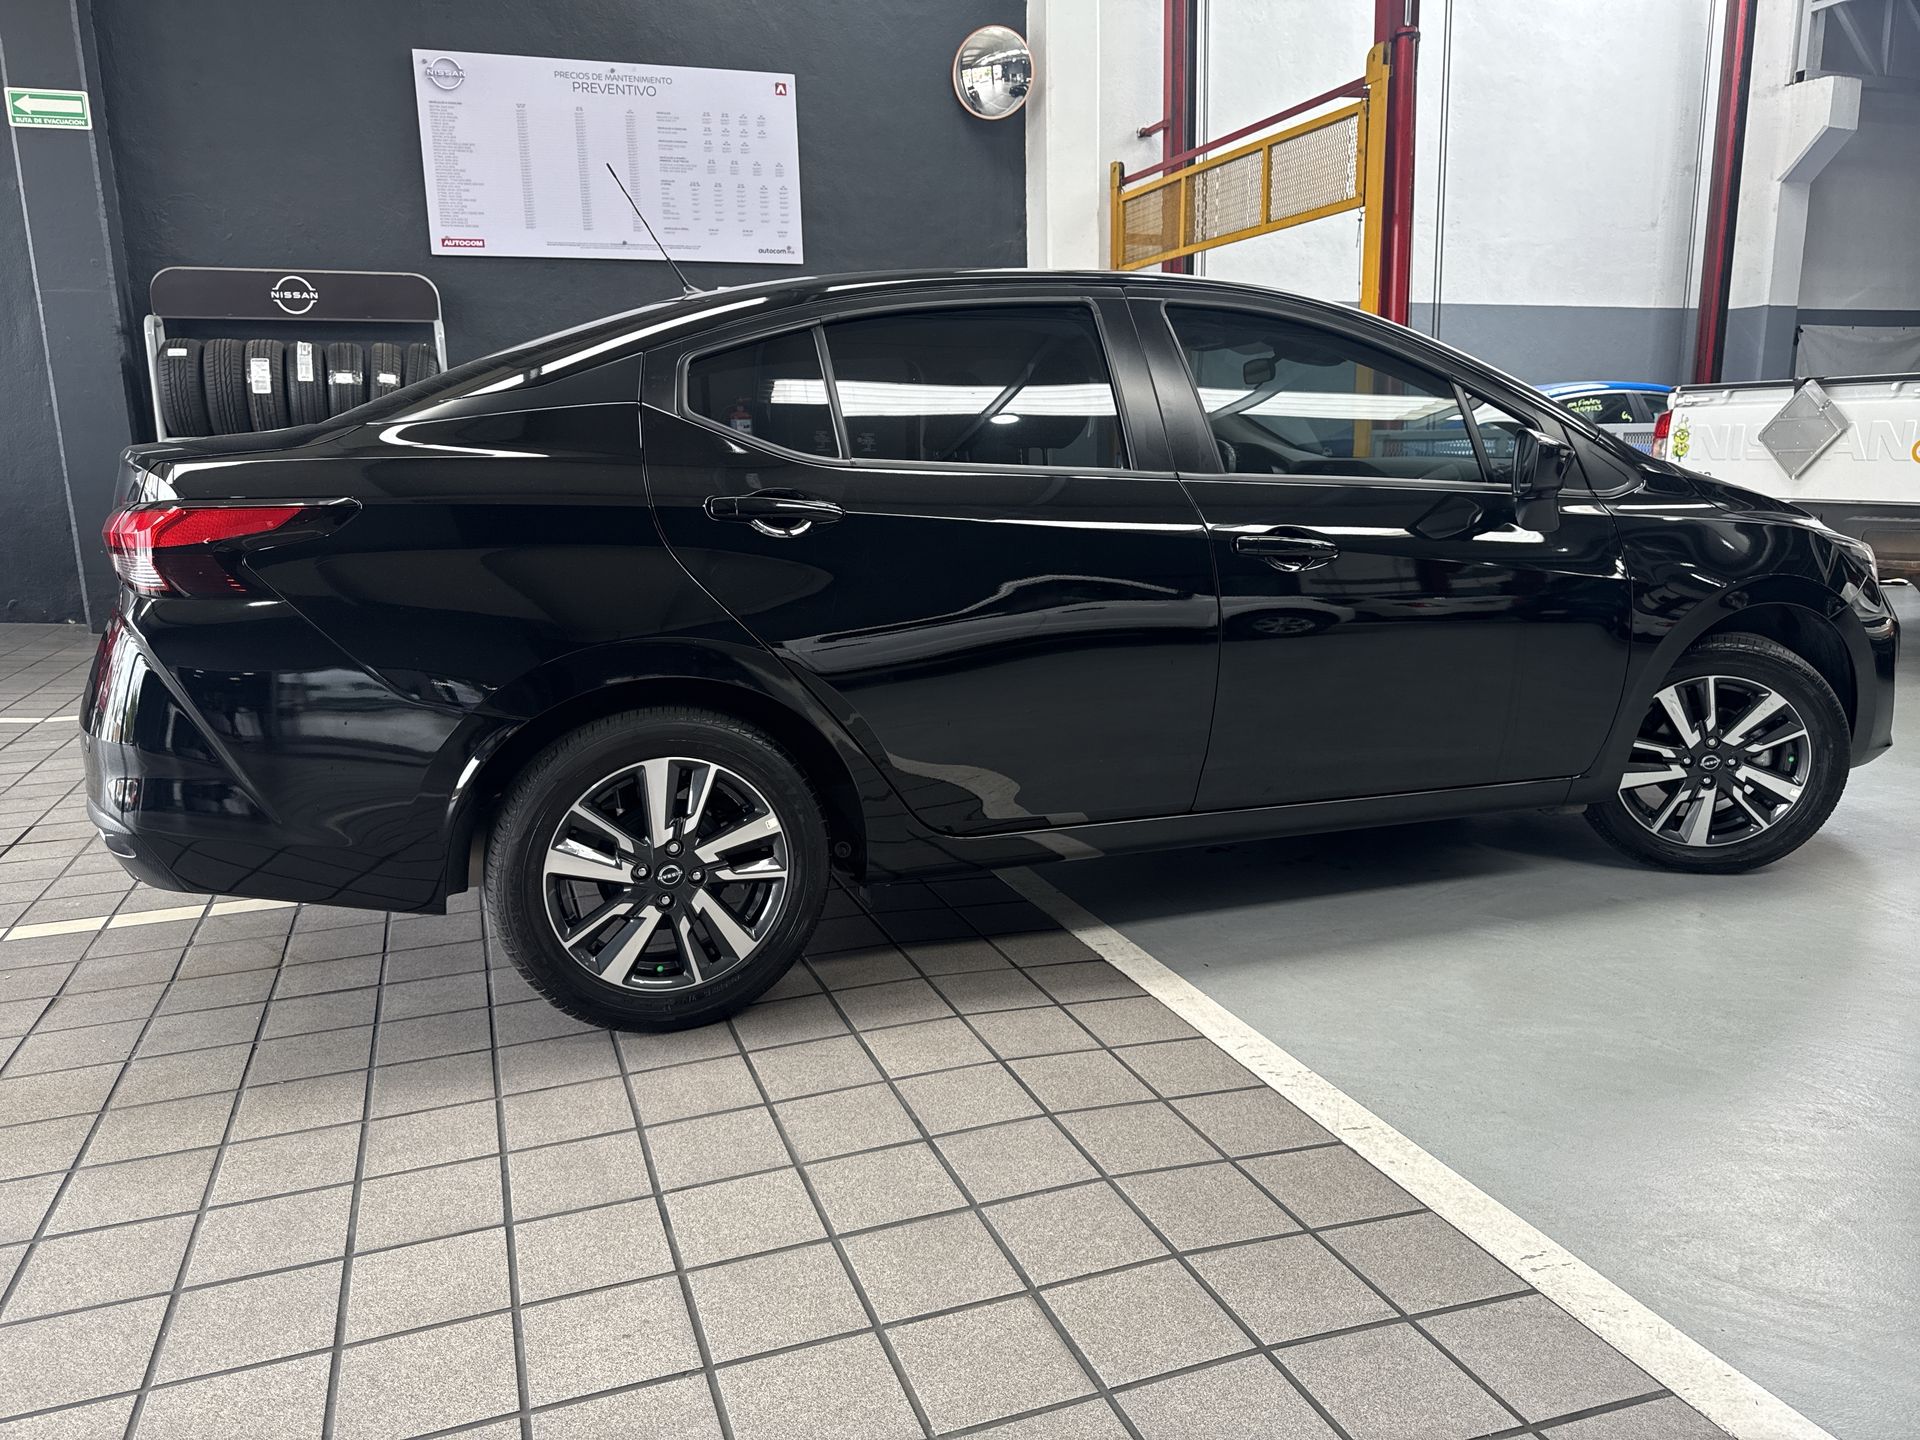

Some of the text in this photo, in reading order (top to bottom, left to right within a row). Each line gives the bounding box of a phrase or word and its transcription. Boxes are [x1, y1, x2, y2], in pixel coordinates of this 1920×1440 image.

[426, 68, 466, 77] NISSAN
[554, 70, 673, 85] PRECIOS DE MANTENIMIENTO
[572, 81, 657, 97] PREVENTIVO
[44, 118, 85, 126] EVACUACION
[443, 239, 483, 247] AUTOCOM
[270, 291, 319, 299] NISSAN
